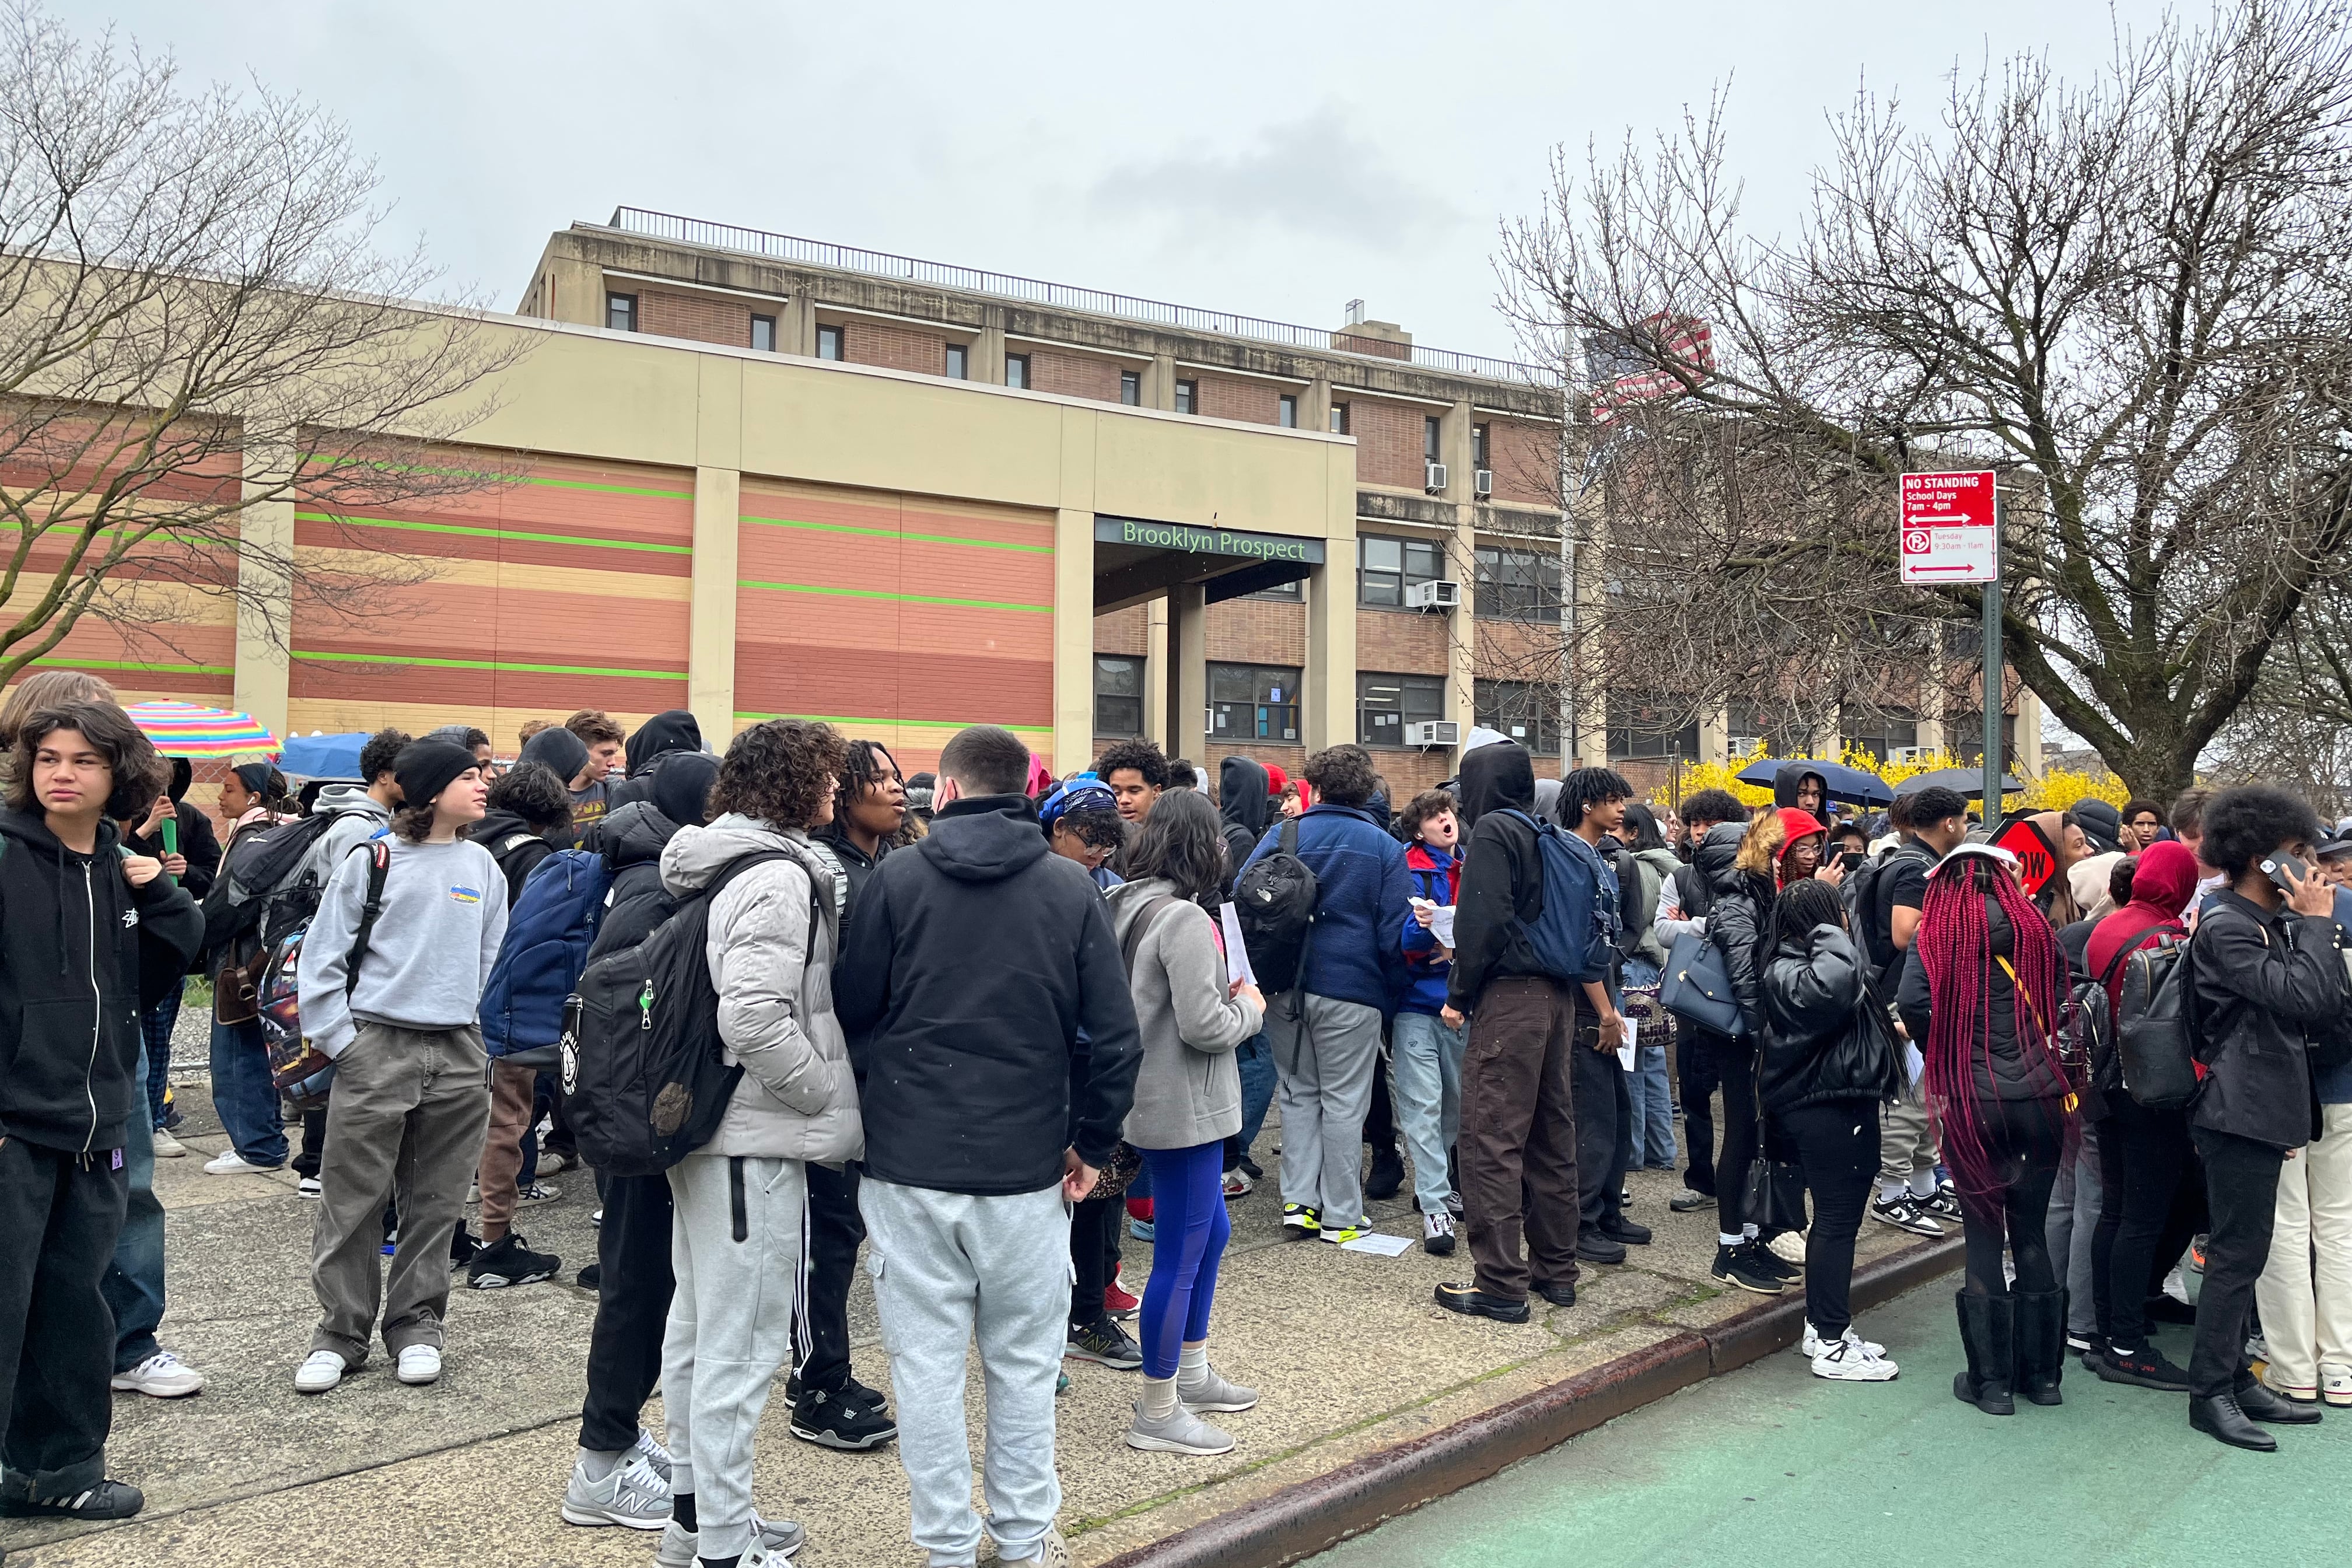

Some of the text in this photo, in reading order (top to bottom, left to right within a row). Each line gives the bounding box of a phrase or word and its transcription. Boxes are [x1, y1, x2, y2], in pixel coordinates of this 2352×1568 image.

[1906, 477, 1979, 489] NO STANDING
[1907, 491, 1957, 501] School Days
[1908, 503, 1924, 511] 7am
[1932, 502, 1951, 512] 4pm
[1124, 522, 1306, 561] Brooklyn Prospect
[2018, 850, 2045, 878] OW
